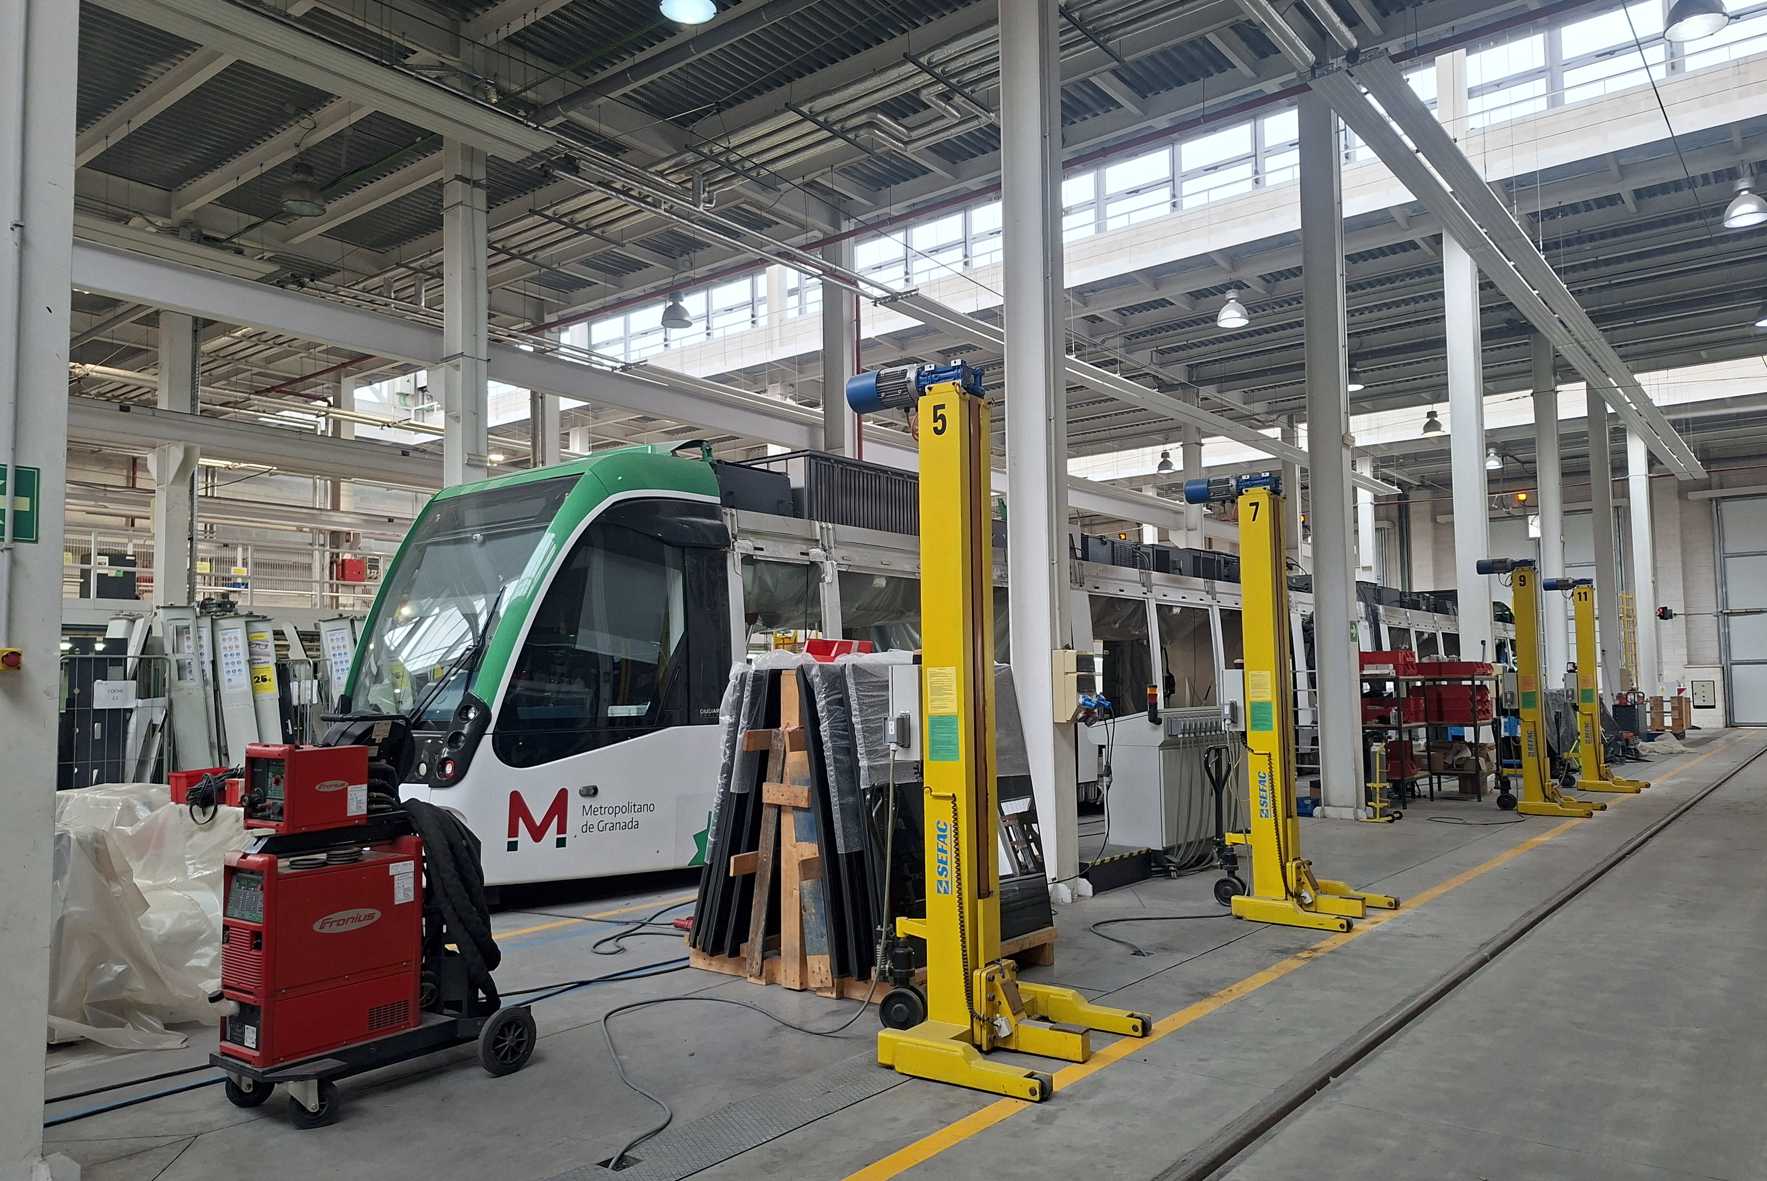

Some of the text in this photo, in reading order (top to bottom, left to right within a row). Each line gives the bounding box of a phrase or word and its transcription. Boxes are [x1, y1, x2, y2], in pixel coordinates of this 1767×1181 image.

[932, 403, 947, 436] 5
[1249, 501, 1260, 522] 7
[1518, 575, 1527, 587] 9
[1577, 591, 1588, 602] 11
[1258, 771, 1268, 808] SEFAC
[507, 787, 569, 852] M
[582, 801, 655, 818] Metropolitano
[581, 817, 640, 834] de Granada
[936, 820, 949, 878] SEFAC
[319, 911, 377, 930] Fronius
